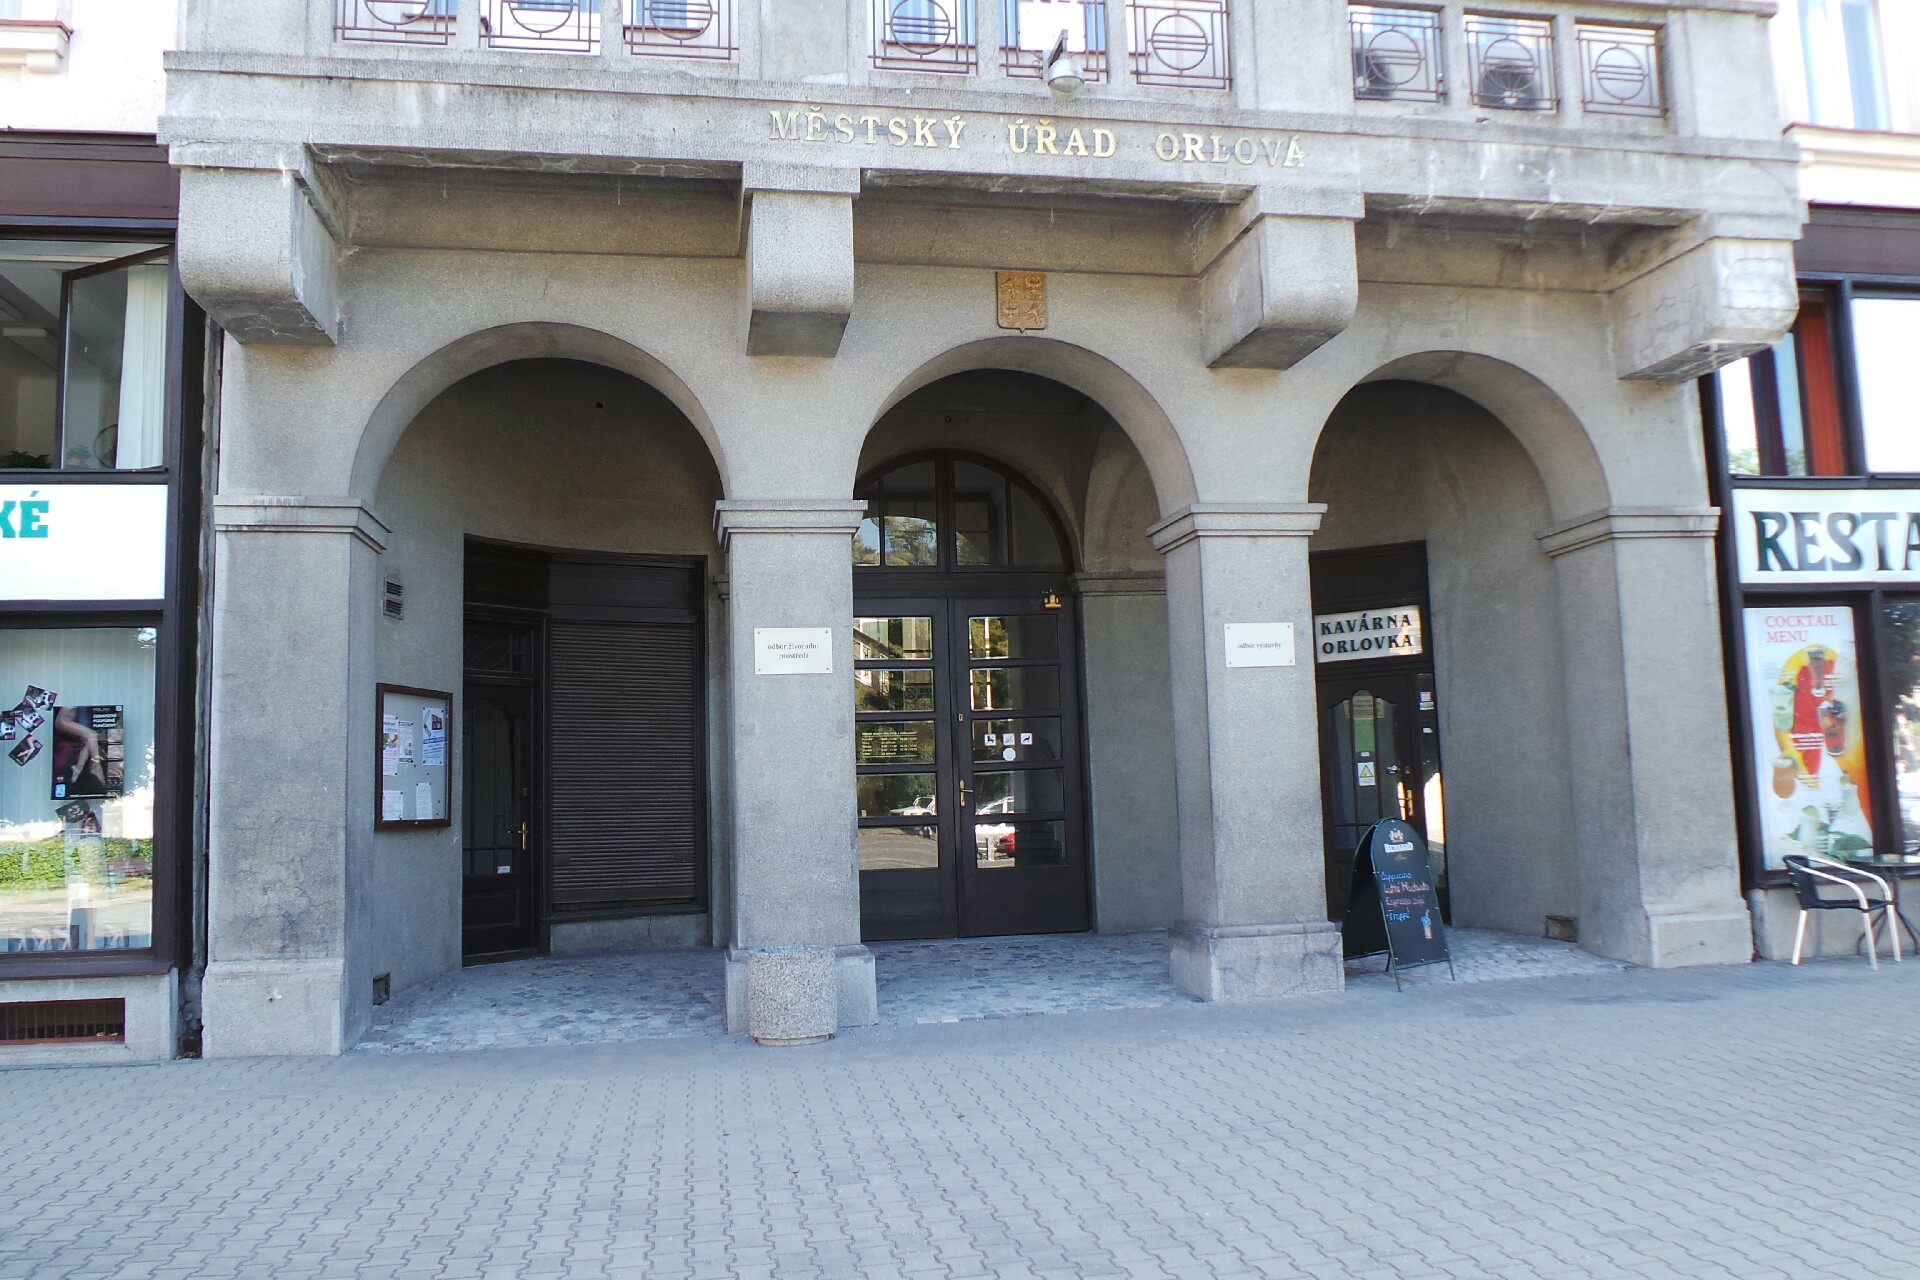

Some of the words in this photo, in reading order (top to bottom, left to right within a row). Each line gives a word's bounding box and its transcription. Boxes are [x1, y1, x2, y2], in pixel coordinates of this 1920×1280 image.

[769, 106, 967, 149] MĚSTSKÝ
[1007, 118, 1117, 158] ÚŘAD
[1155, 133, 1305, 168] ORLOVÁ
[1320, 613, 1412, 635] KAVÁRNA
[1764, 614, 1839, 627] COCKTAIL
[1322, 634, 1414, 654] ORLOVKA
[1766, 630, 1808, 643] MENU
